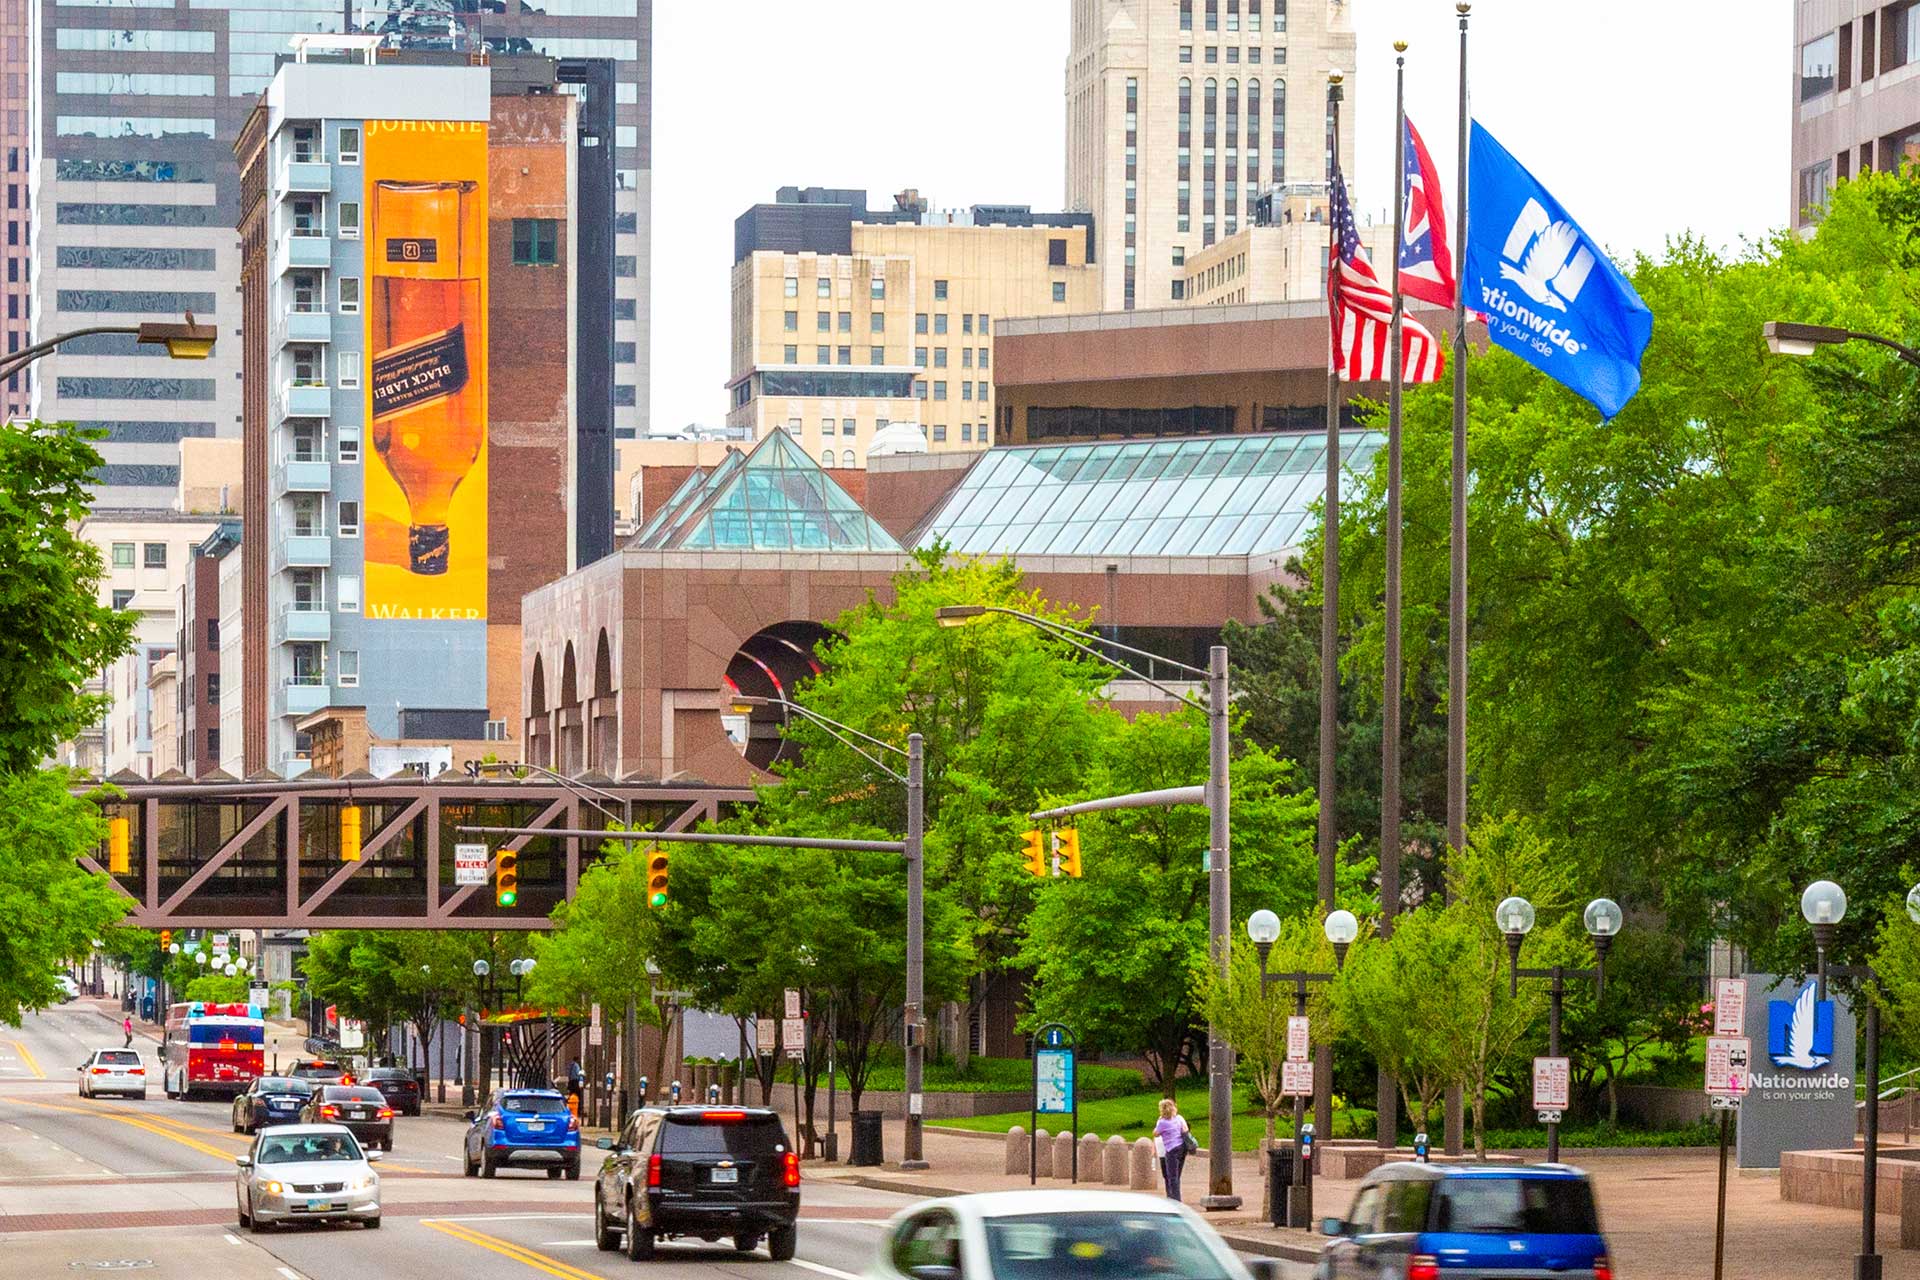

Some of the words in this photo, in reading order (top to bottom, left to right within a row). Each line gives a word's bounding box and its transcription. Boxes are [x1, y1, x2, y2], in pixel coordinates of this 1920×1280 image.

[368, 120, 481, 136] JOHNNIE
[1499, 321, 1530, 342] your
[1530, 337, 1553, 357] side
[411, 364, 452, 386] BLACK
[371, 604, 480, 619] WALKER
[1748, 1073, 1850, 1089] Nationwide
[1763, 1090, 1770, 1100] is
[1773, 1092, 1786, 1100] on
[1789, 1092, 1811, 1101] your
[1814, 1090, 1835, 1100] side
